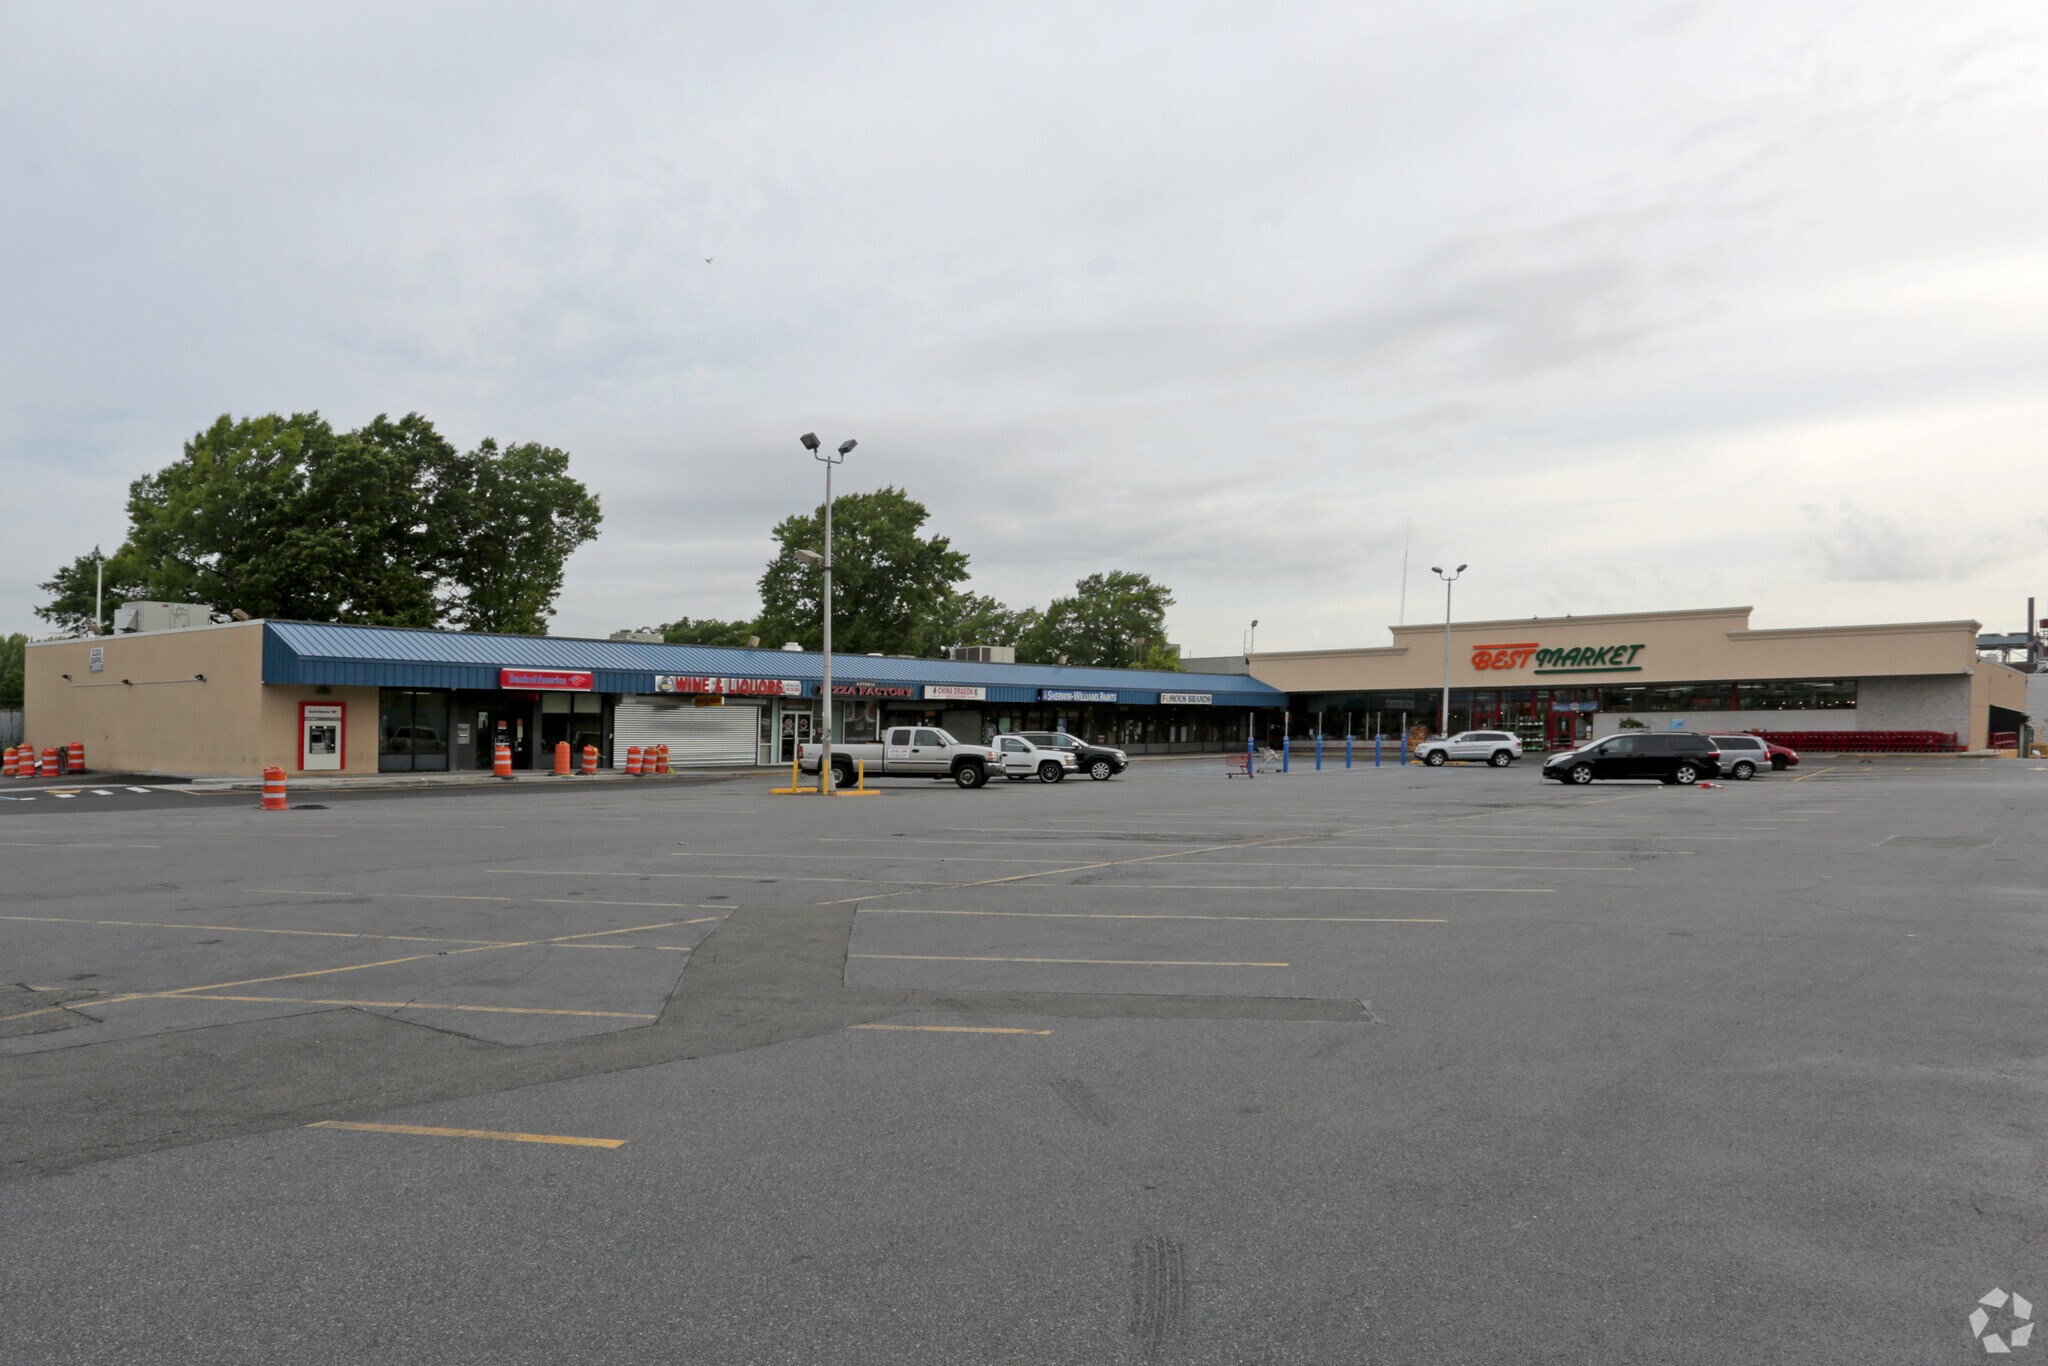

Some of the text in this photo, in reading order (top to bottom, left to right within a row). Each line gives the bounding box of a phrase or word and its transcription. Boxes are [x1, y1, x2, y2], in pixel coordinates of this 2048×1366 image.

[1471, 644, 1646, 671] BEST MARKET
[538, 675, 567, 685] America
[675, 676, 783, 695] WINE & LIQUORS
[859, 687, 914, 697] FACTORY
[937, 687, 974, 695] CHINA DRAGON
[1187, 695, 1212, 703] BRANDS
